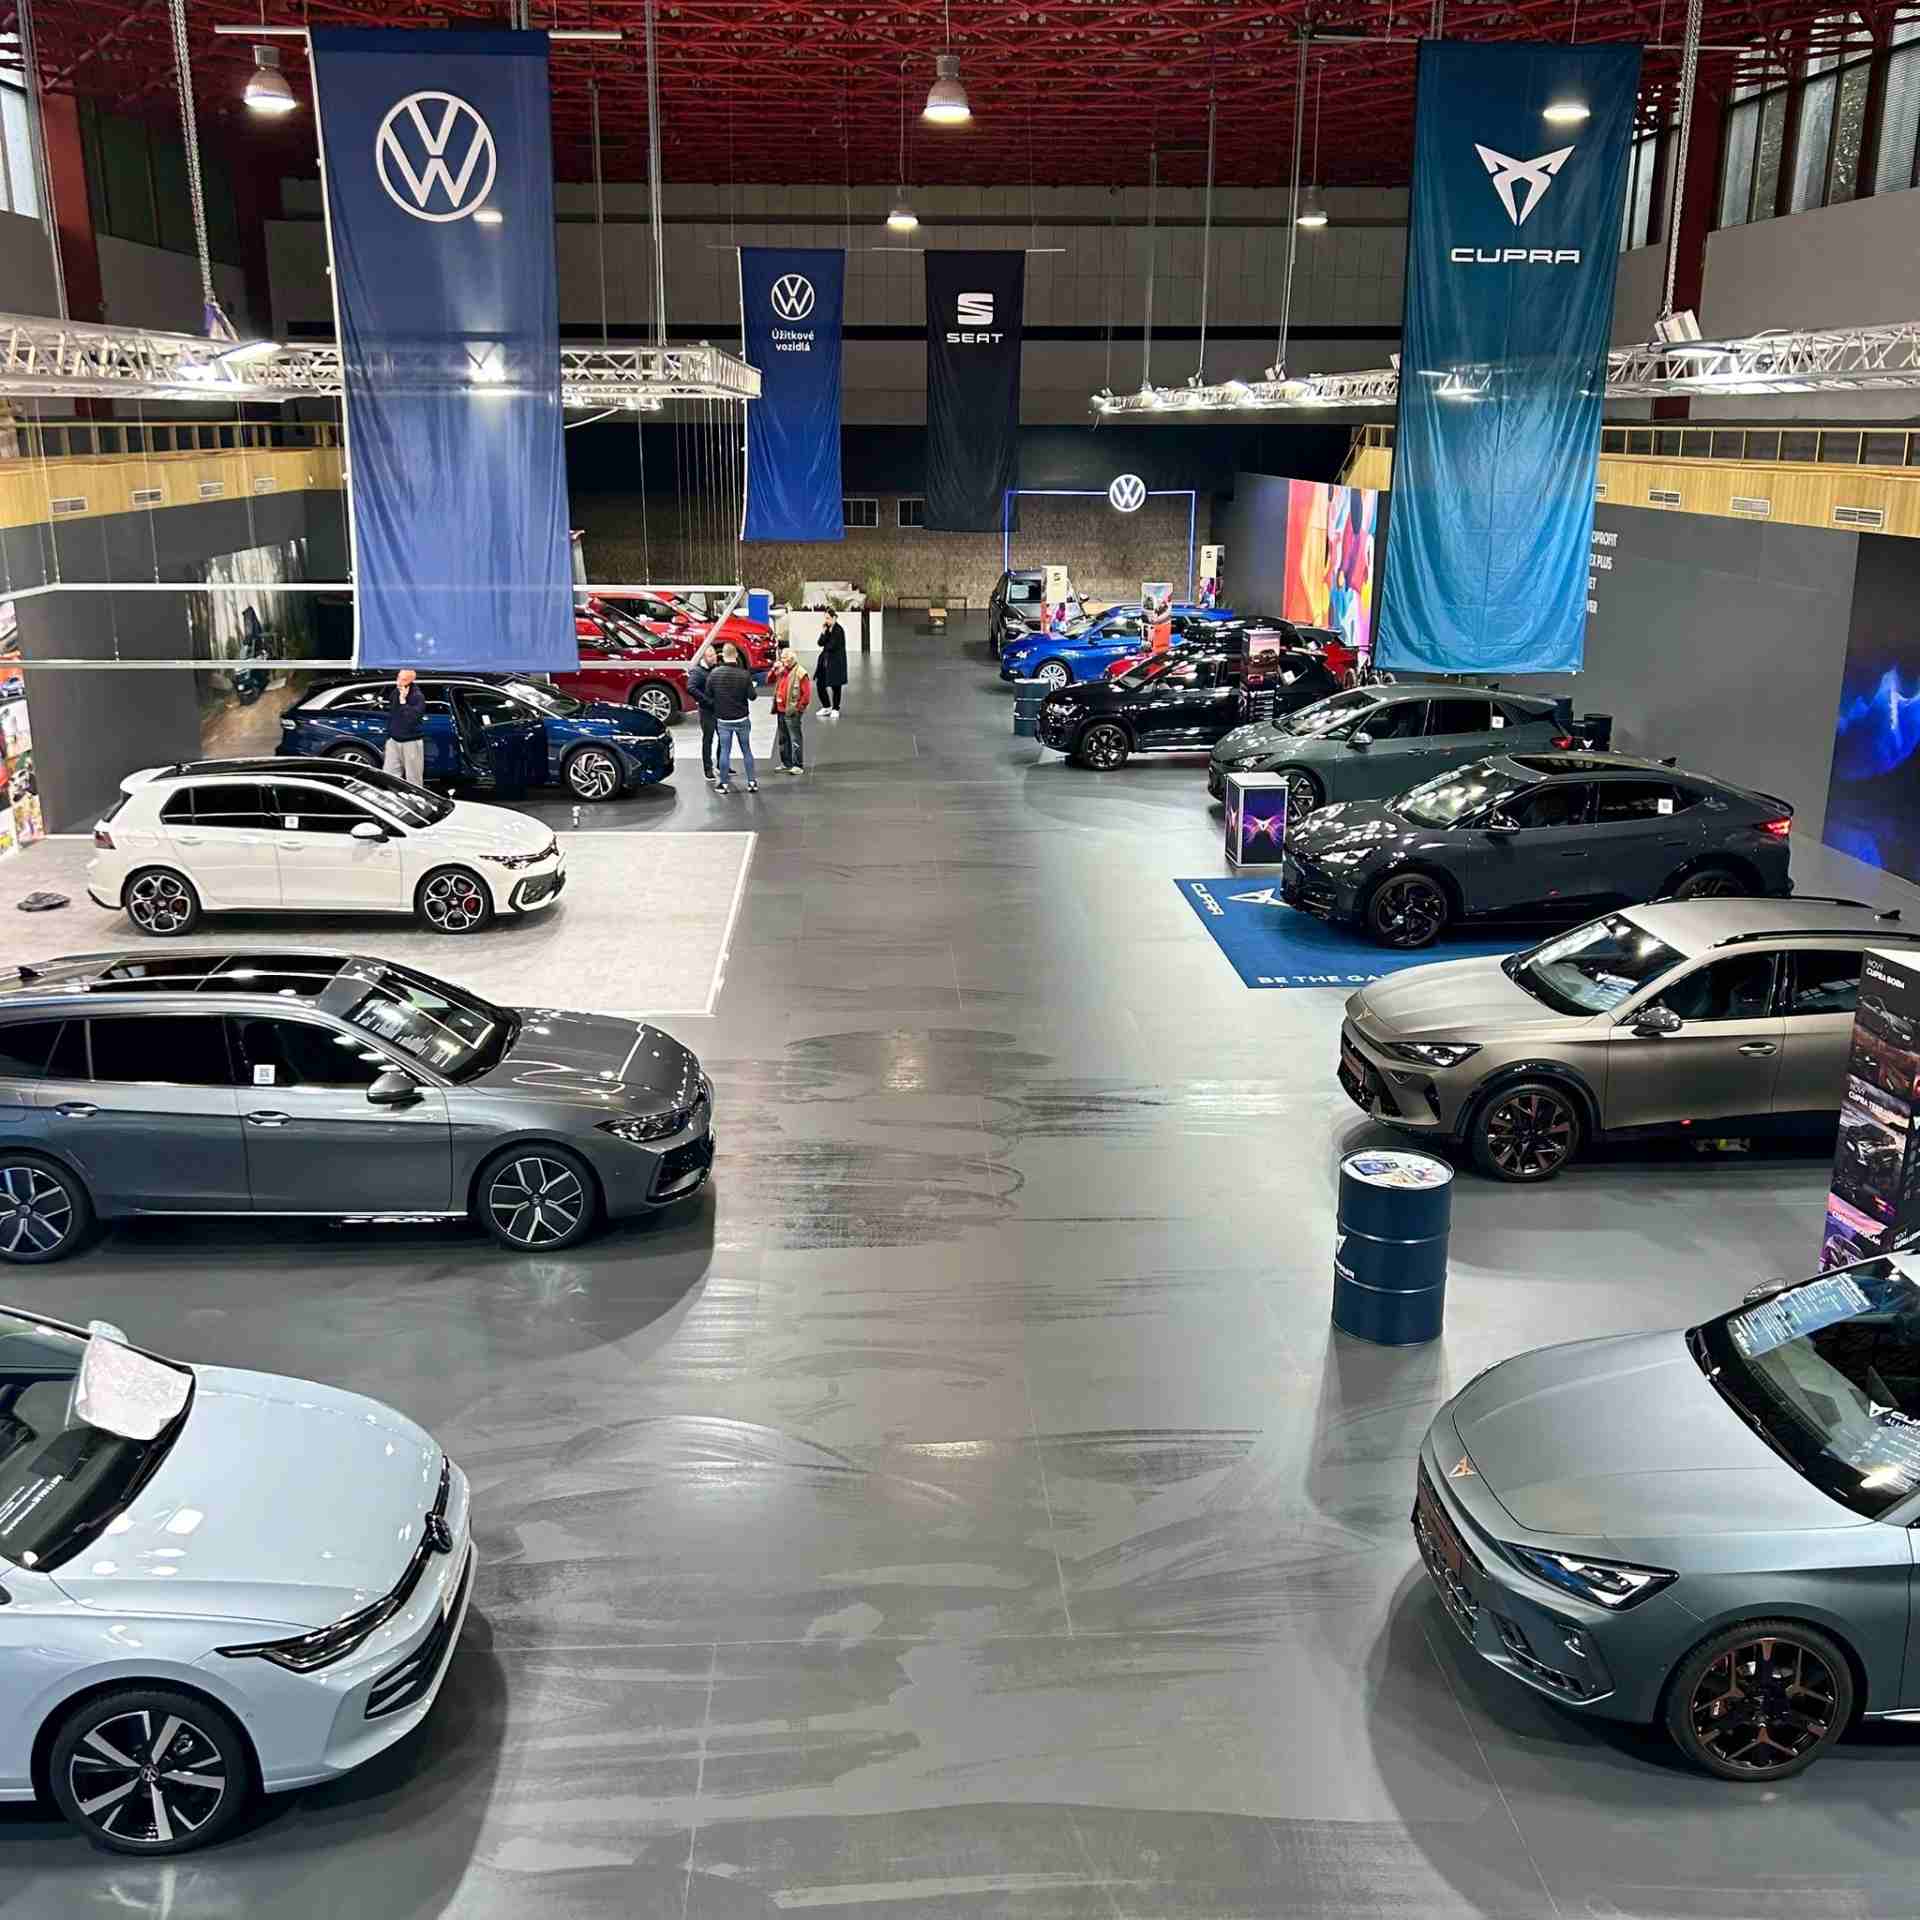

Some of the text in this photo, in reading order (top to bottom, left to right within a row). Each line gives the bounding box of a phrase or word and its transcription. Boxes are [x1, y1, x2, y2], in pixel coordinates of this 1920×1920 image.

[1450, 247, 1581, 265] CUPRA
[770, 328, 815, 341] Úžitkové
[946, 332, 1004, 344] SEAT
[775, 340, 811, 352] vozidlá
[1190, 882, 1225, 915] CUPRA
[1257, 974, 1385, 984] BE THE GA
